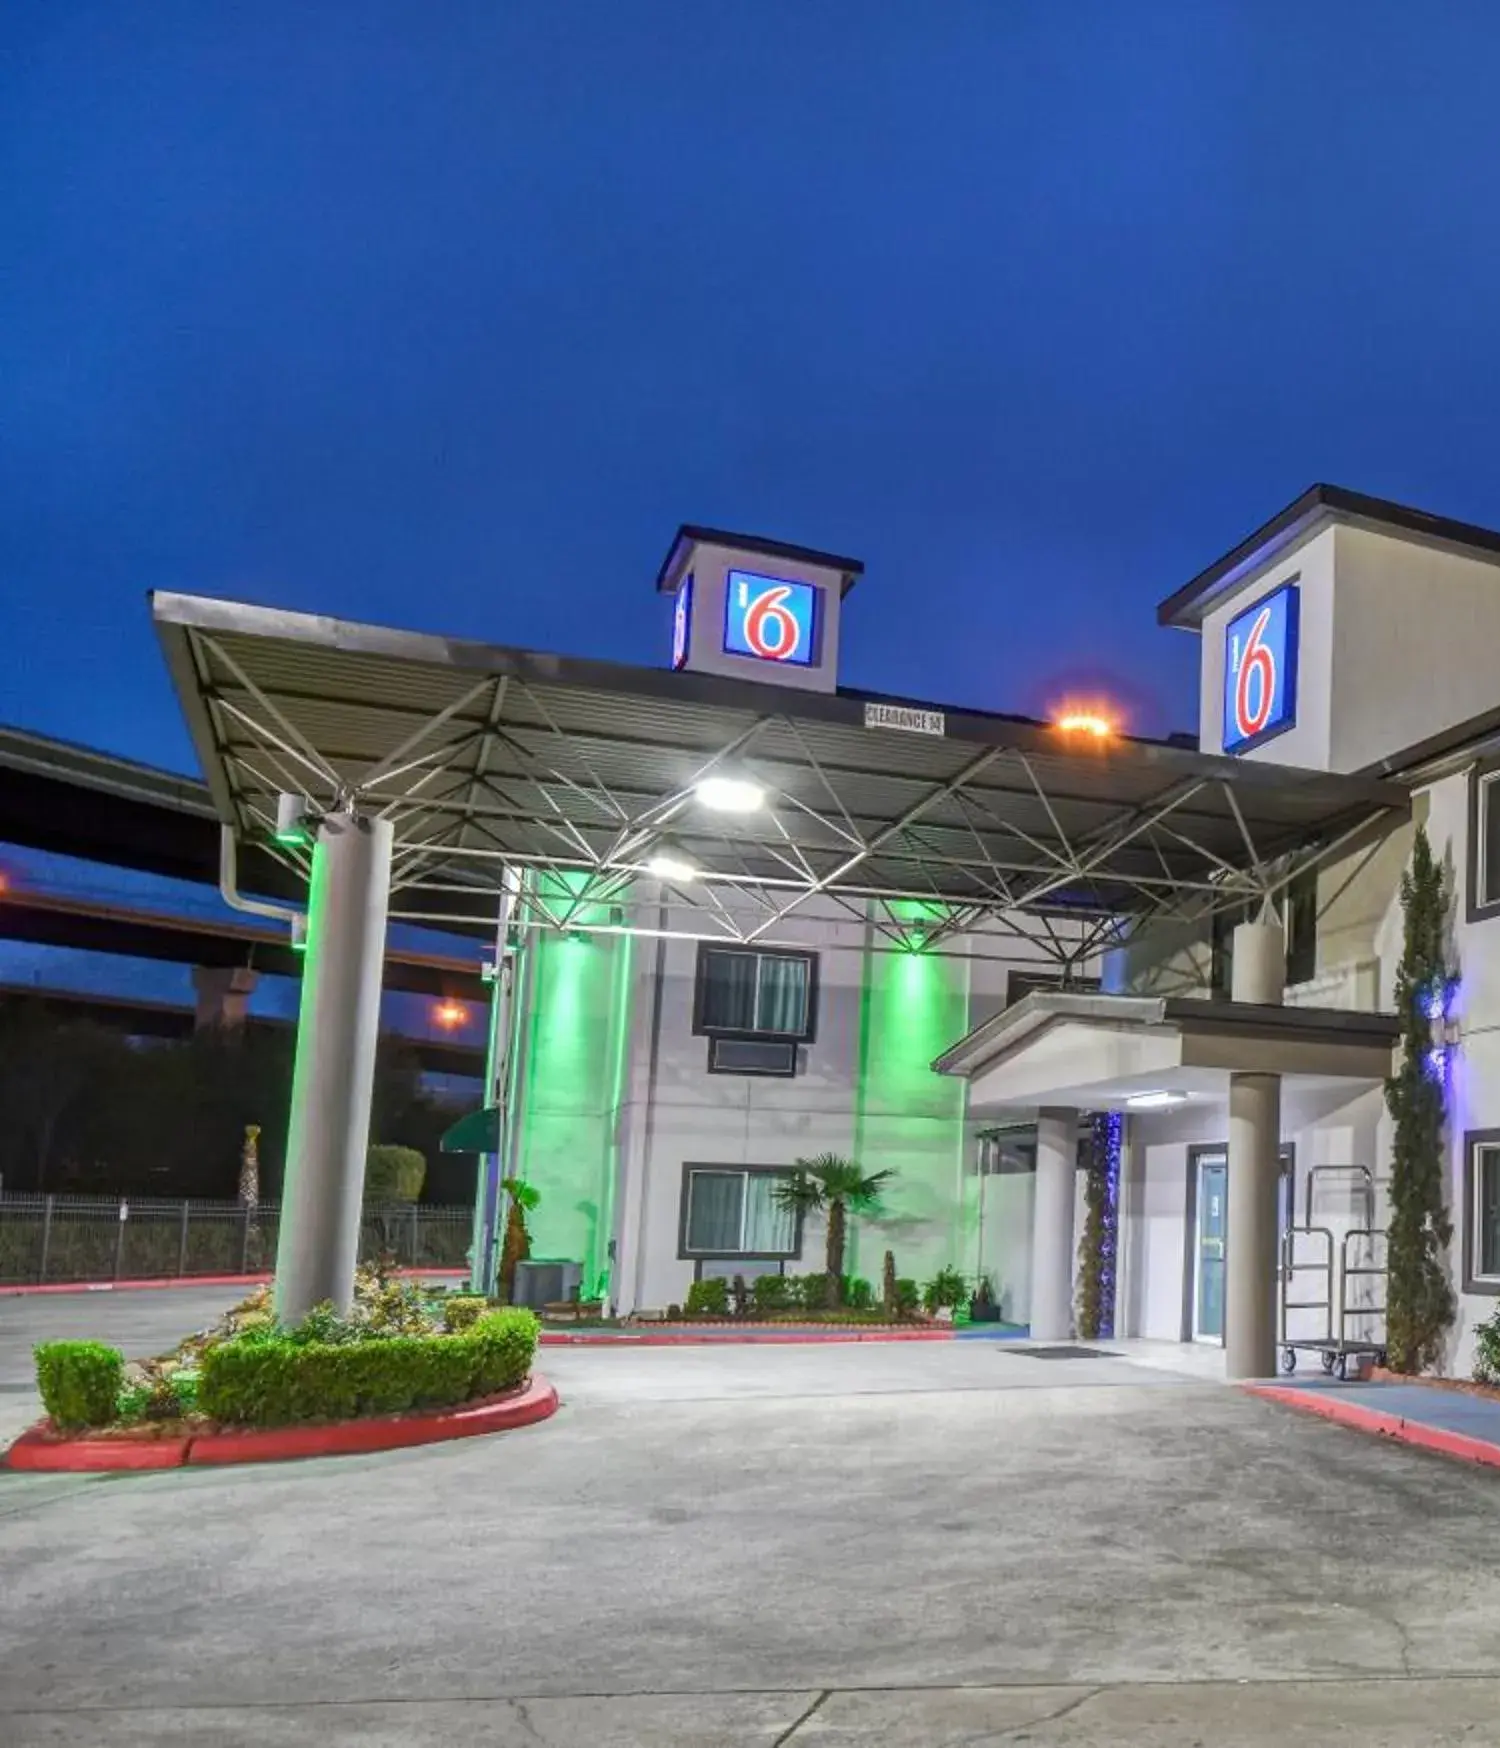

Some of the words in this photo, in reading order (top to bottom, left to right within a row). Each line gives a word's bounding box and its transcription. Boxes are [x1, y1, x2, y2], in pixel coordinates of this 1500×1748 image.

[744, 586, 799, 659] 6
[1235, 607, 1276, 738] 6
[865, 705, 927, 729] CLEARANCE
